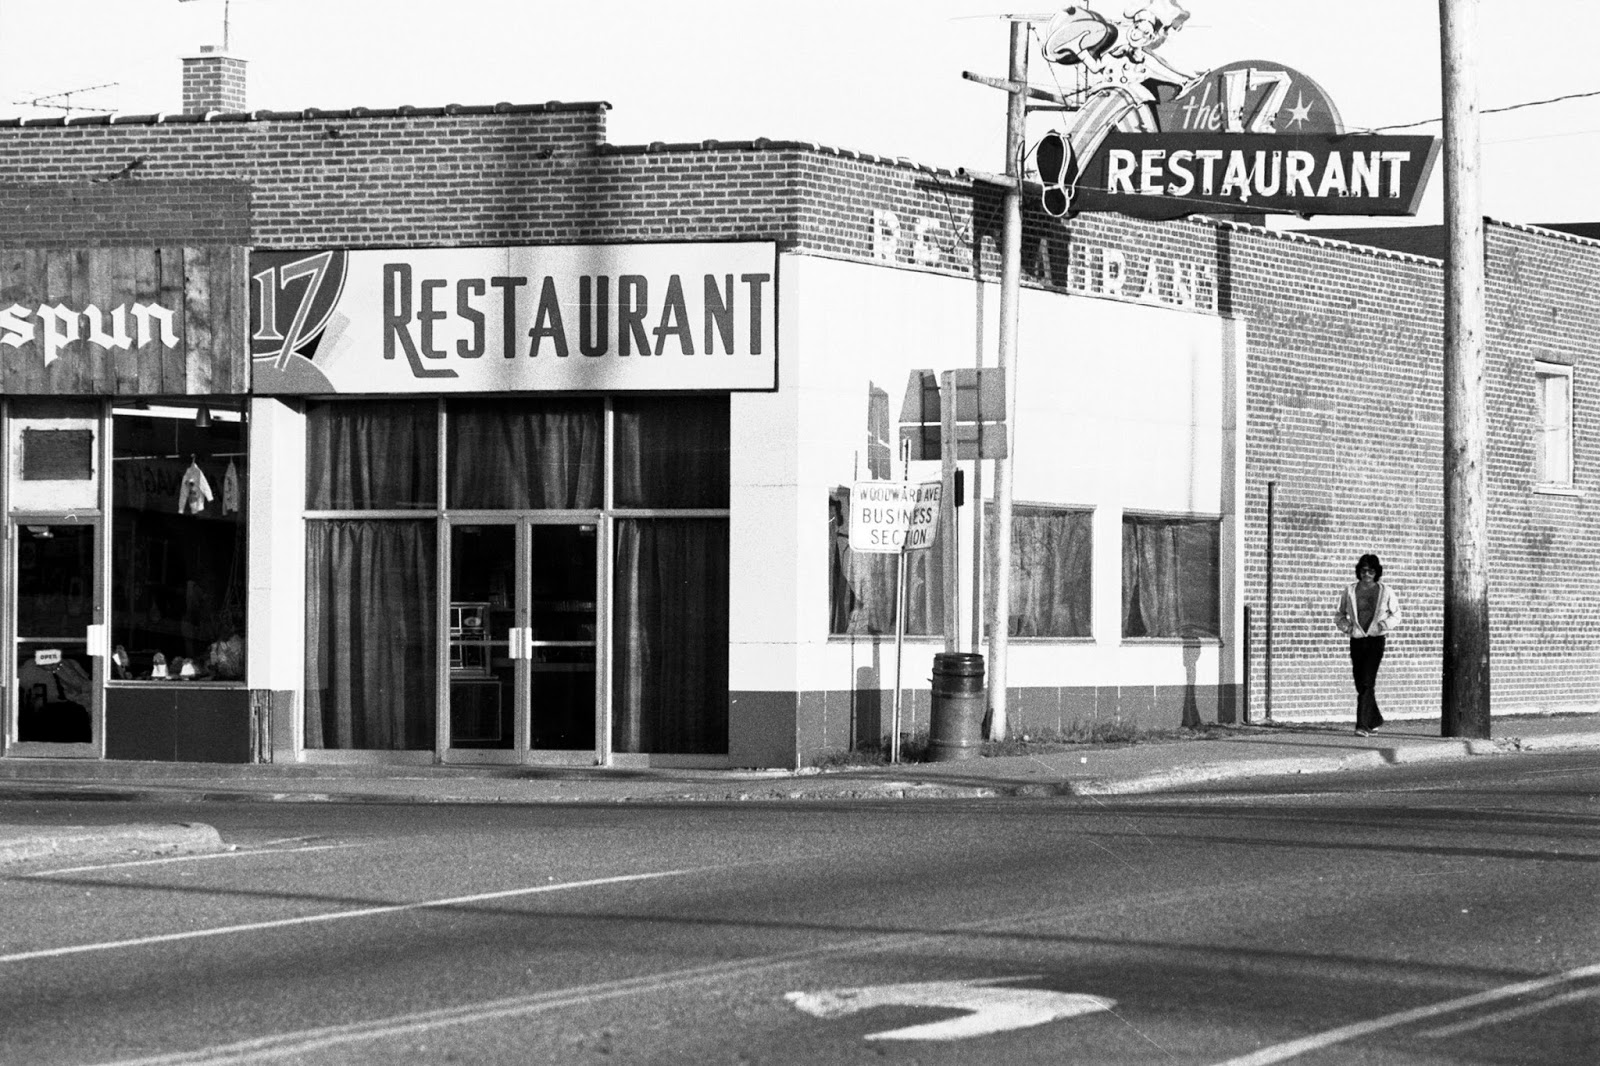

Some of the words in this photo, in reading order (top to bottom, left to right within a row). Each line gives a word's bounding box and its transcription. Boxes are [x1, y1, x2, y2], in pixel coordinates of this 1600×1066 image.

[1182, 82, 1225, 131] the
[1223, 67, 1293, 134] 17
[1107, 149, 1411, 202] RESTAURANT
[0, 302, 180, 367] spun
[252, 251, 334, 372] 17
[383, 262, 771, 378] RESTAURANT
[860, 487, 922, 502] WOODWARD
[862, 507, 932, 525] BUSINESS
[871, 528, 927, 546] SECTION
